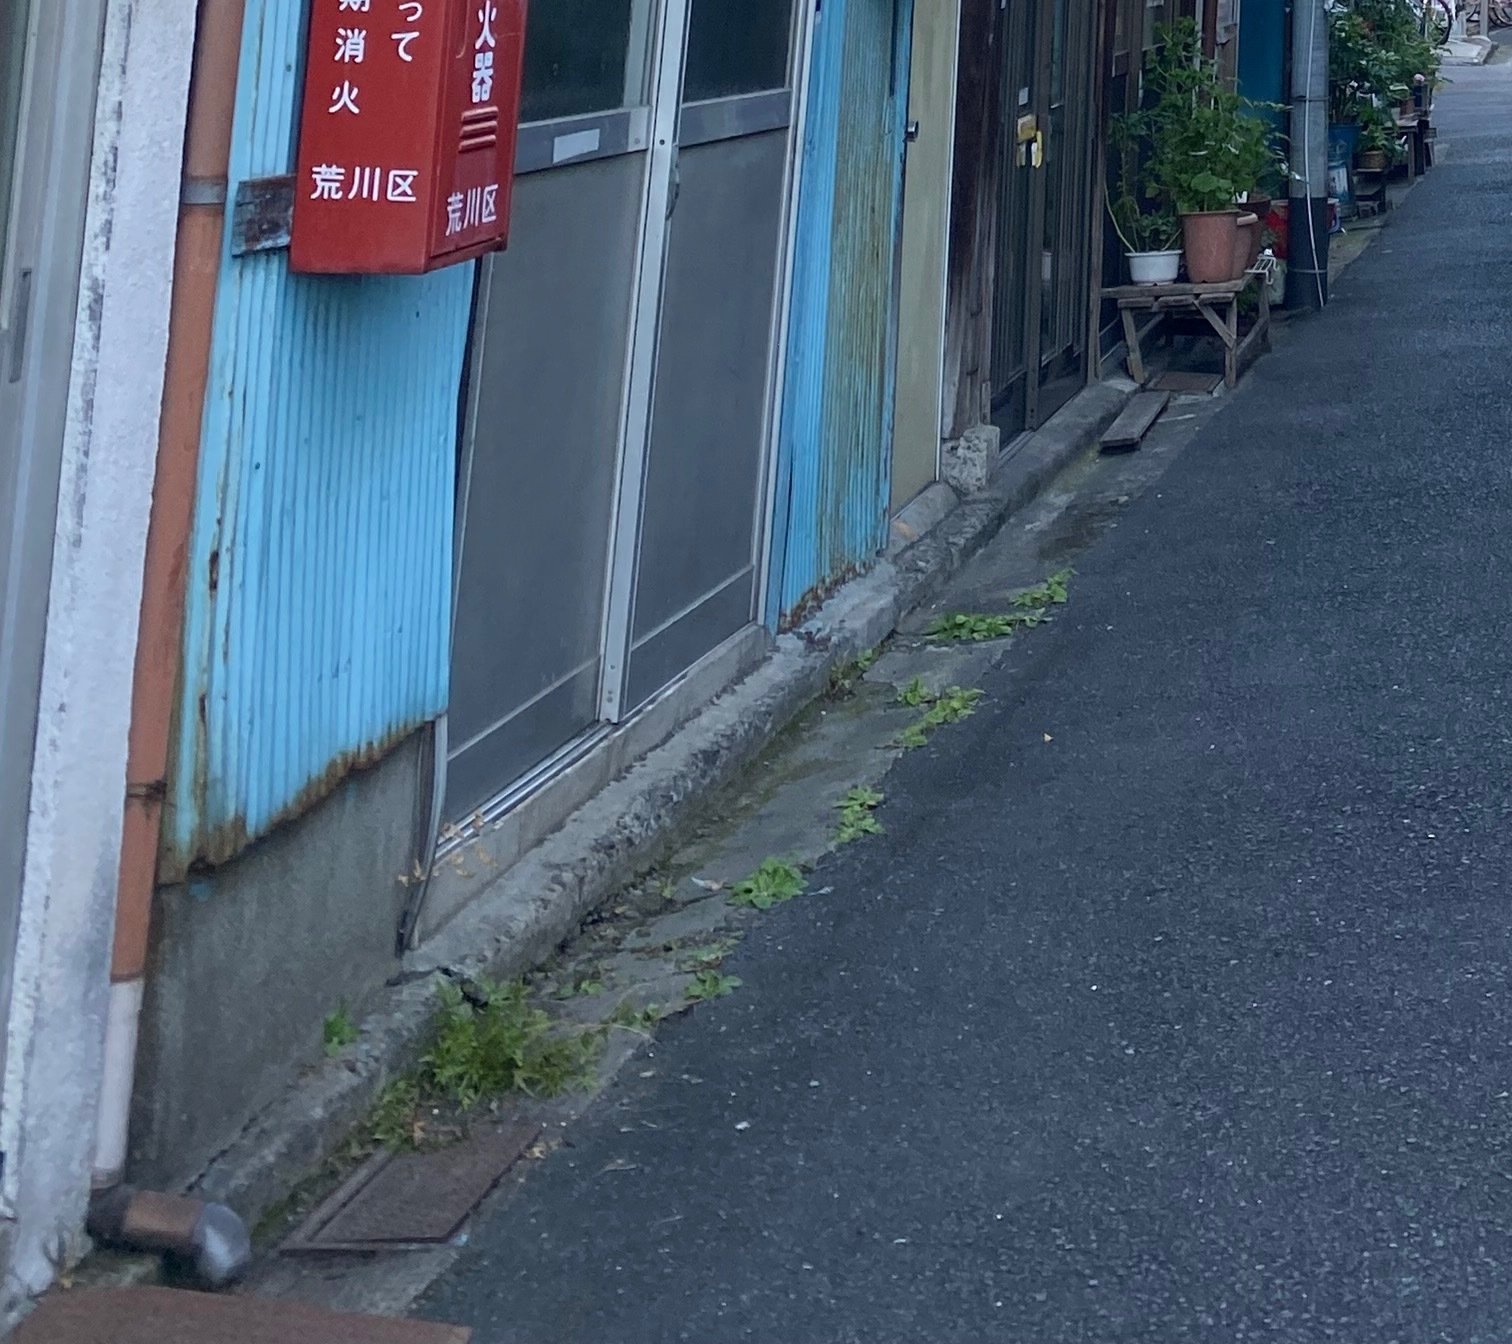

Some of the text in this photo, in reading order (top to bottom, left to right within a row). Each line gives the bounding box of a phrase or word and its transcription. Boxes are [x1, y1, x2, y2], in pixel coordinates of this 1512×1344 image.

[310, 164, 419, 202] 荒川区
[445, 183, 499, 236] 荒川区
